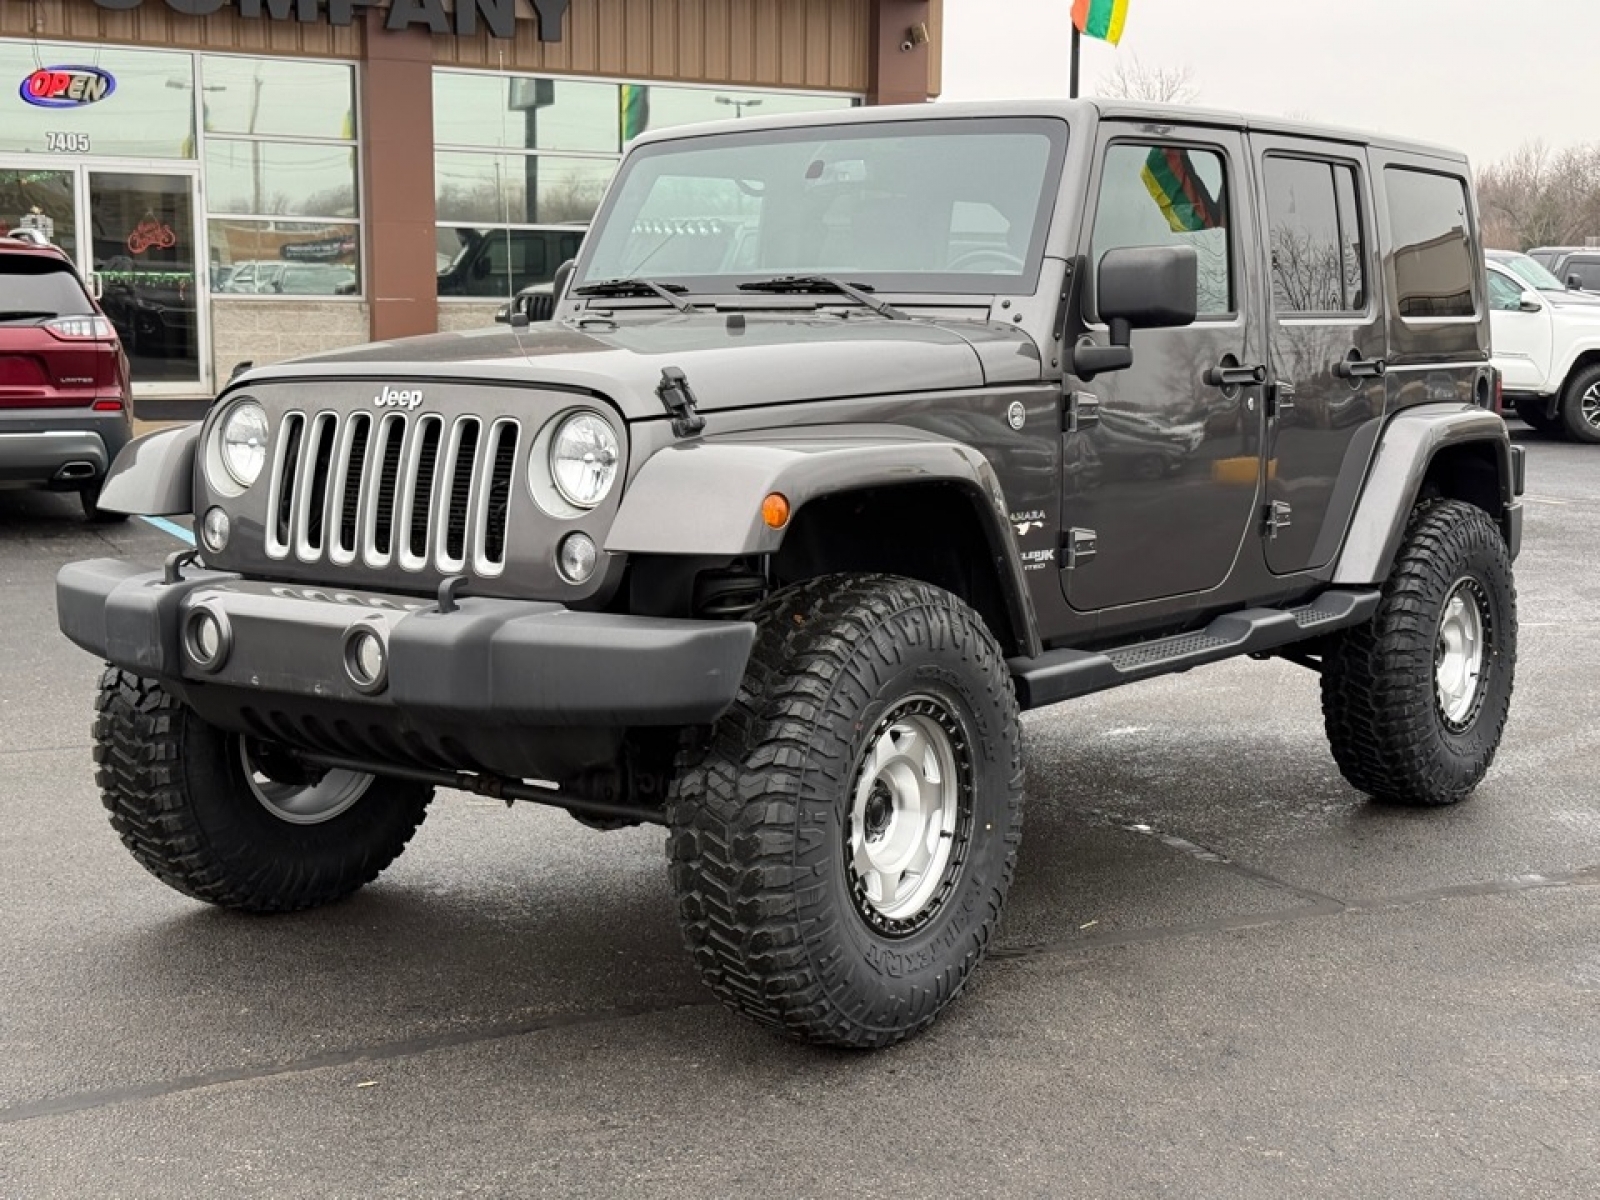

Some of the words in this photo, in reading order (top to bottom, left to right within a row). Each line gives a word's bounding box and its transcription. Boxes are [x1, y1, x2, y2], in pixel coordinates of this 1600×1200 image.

[29, 70, 107, 101] OPEN
[46, 132, 91, 152] 7405
[374, 386, 423, 411] Jeep
